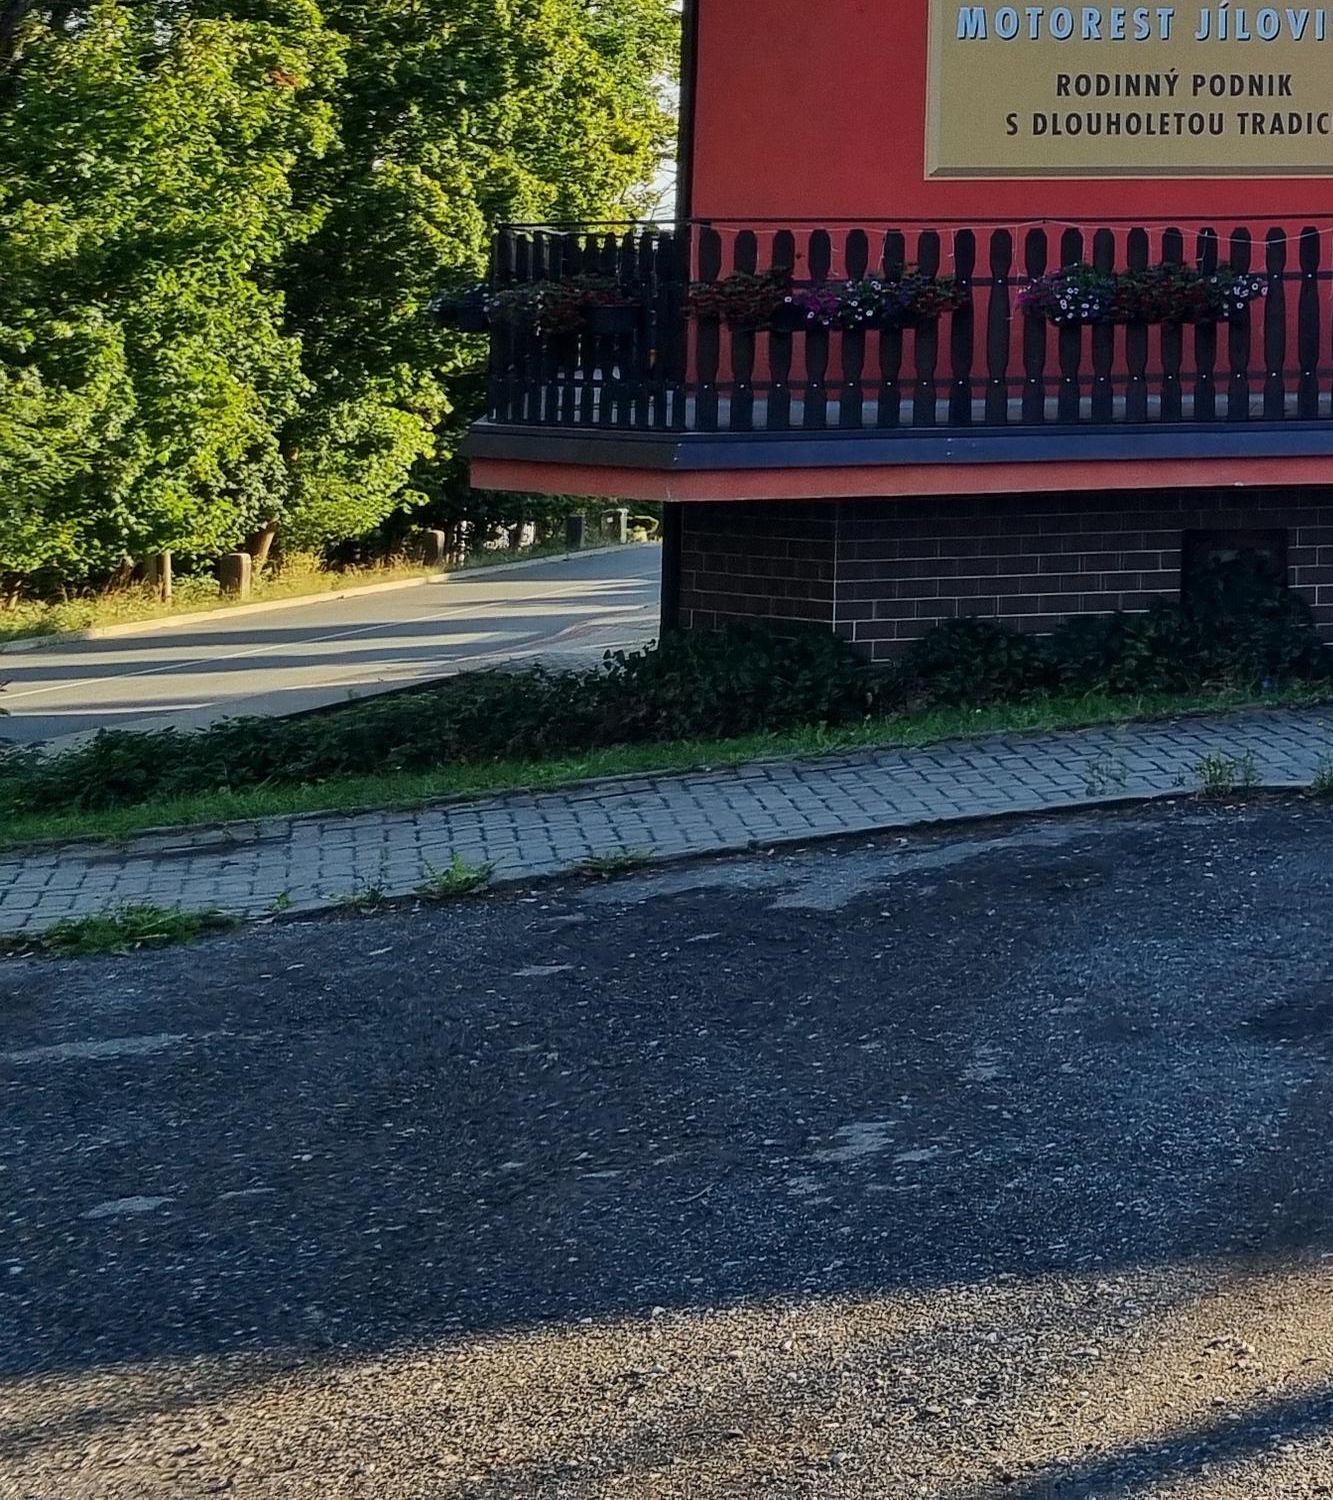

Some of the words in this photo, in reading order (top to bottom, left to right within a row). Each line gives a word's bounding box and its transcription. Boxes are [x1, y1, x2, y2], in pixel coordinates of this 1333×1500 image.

[956, 6, 1175, 41] MOTOREST
[1056, 68, 1180, 97] RODINNÝ
[1192, 74, 1293, 97] PODNIK
[1006, 112, 1018, 135] S
[1032, 112, 1225, 135] DLOUHOLETOU
